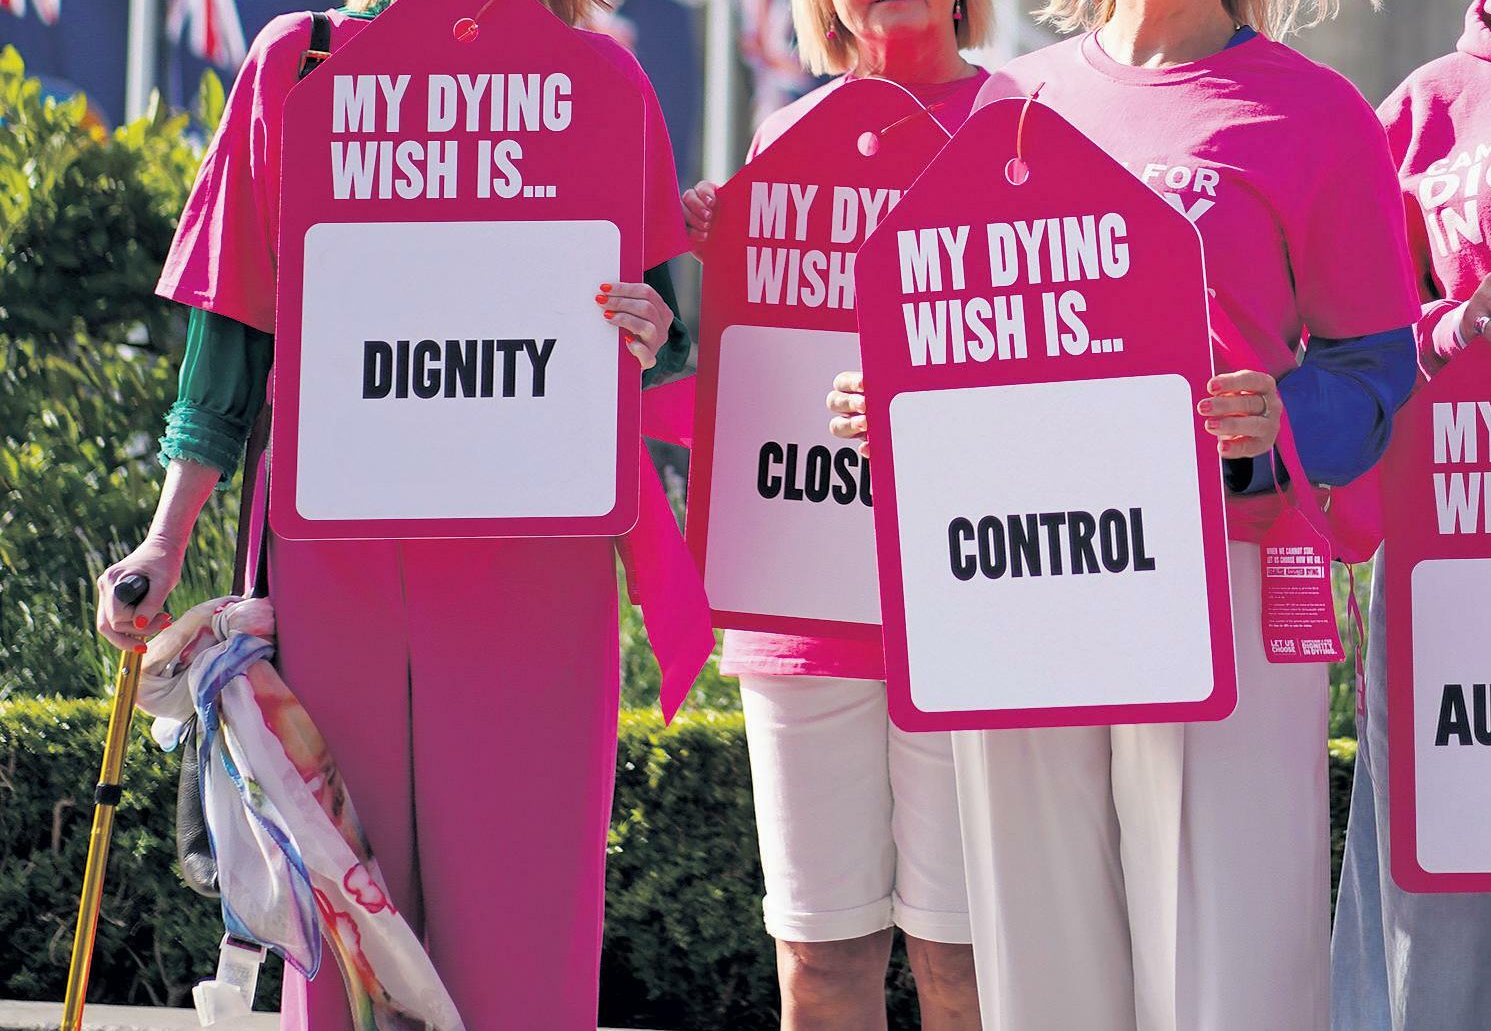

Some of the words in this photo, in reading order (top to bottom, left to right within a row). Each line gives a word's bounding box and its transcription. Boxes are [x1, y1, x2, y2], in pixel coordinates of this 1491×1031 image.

[333, 74, 411, 132] MY
[427, 72, 572, 132] DYING
[332, 140, 459, 200] WISH
[477, 140, 556, 199] IS...
[1141, 163, 1219, 197] FOR
[748, 181, 819, 241] MY
[831, 186, 908, 244] DY
[1427, 197, 1482, 257] IN
[747, 246, 857, 309] WISH
[897, 225, 970, 294] MY
[987, 212, 1130, 287] DYING
[902, 294, 1028, 366] WISH
[1042, 290, 1124, 357] IS...
[363, 339, 556, 399] DIGNITY
[948, 507, 1156, 581] CONTROL
